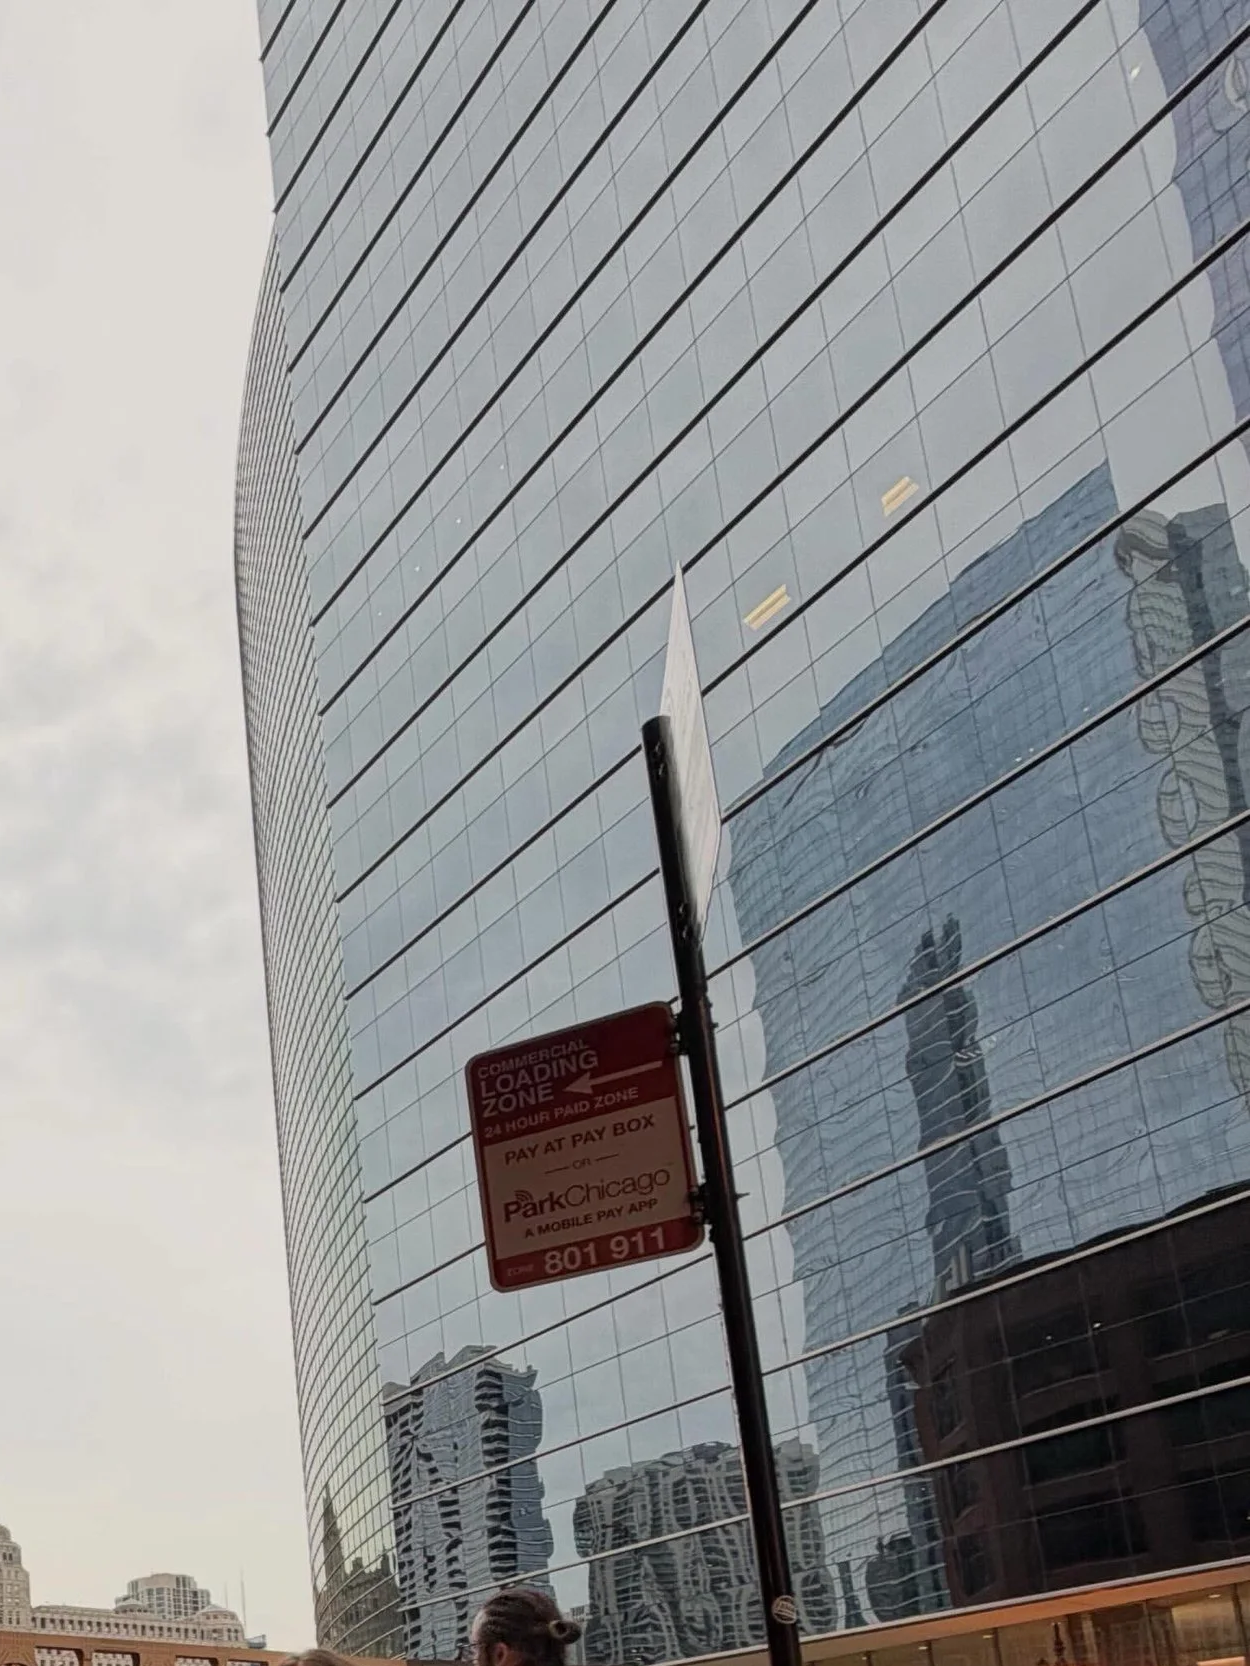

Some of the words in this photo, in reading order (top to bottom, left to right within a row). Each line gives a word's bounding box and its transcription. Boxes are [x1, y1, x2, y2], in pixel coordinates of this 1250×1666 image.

[478, 1039, 590, 1079] COMMERCIAL
[480, 1051, 599, 1098] LOADING
[482, 1082, 554, 1118] ZONE
[484, 1123, 502, 1139] 24
[505, 1111, 550, 1133] HOUR
[554, 1100, 590, 1119] PAID
[594, 1086, 639, 1109] ZONE
[505, 1144, 539, 1166] PAY
[544, 1137, 567, 1155] AT
[571, 1126, 606, 1149] PAY
[613, 1113, 655, 1137] BOX
[572, 1157, 592, 1170] OR
[503, 1169, 671, 1223] ParkChicago
[524, 1227, 535, 1239] A
[538, 1213, 593, 1236] MOBILE
[597, 1205, 624, 1221] PAY
[629, 1198, 658, 1215] APP
[544, 1241, 598, 1274] 801
[610, 1226, 665, 1259] 911
